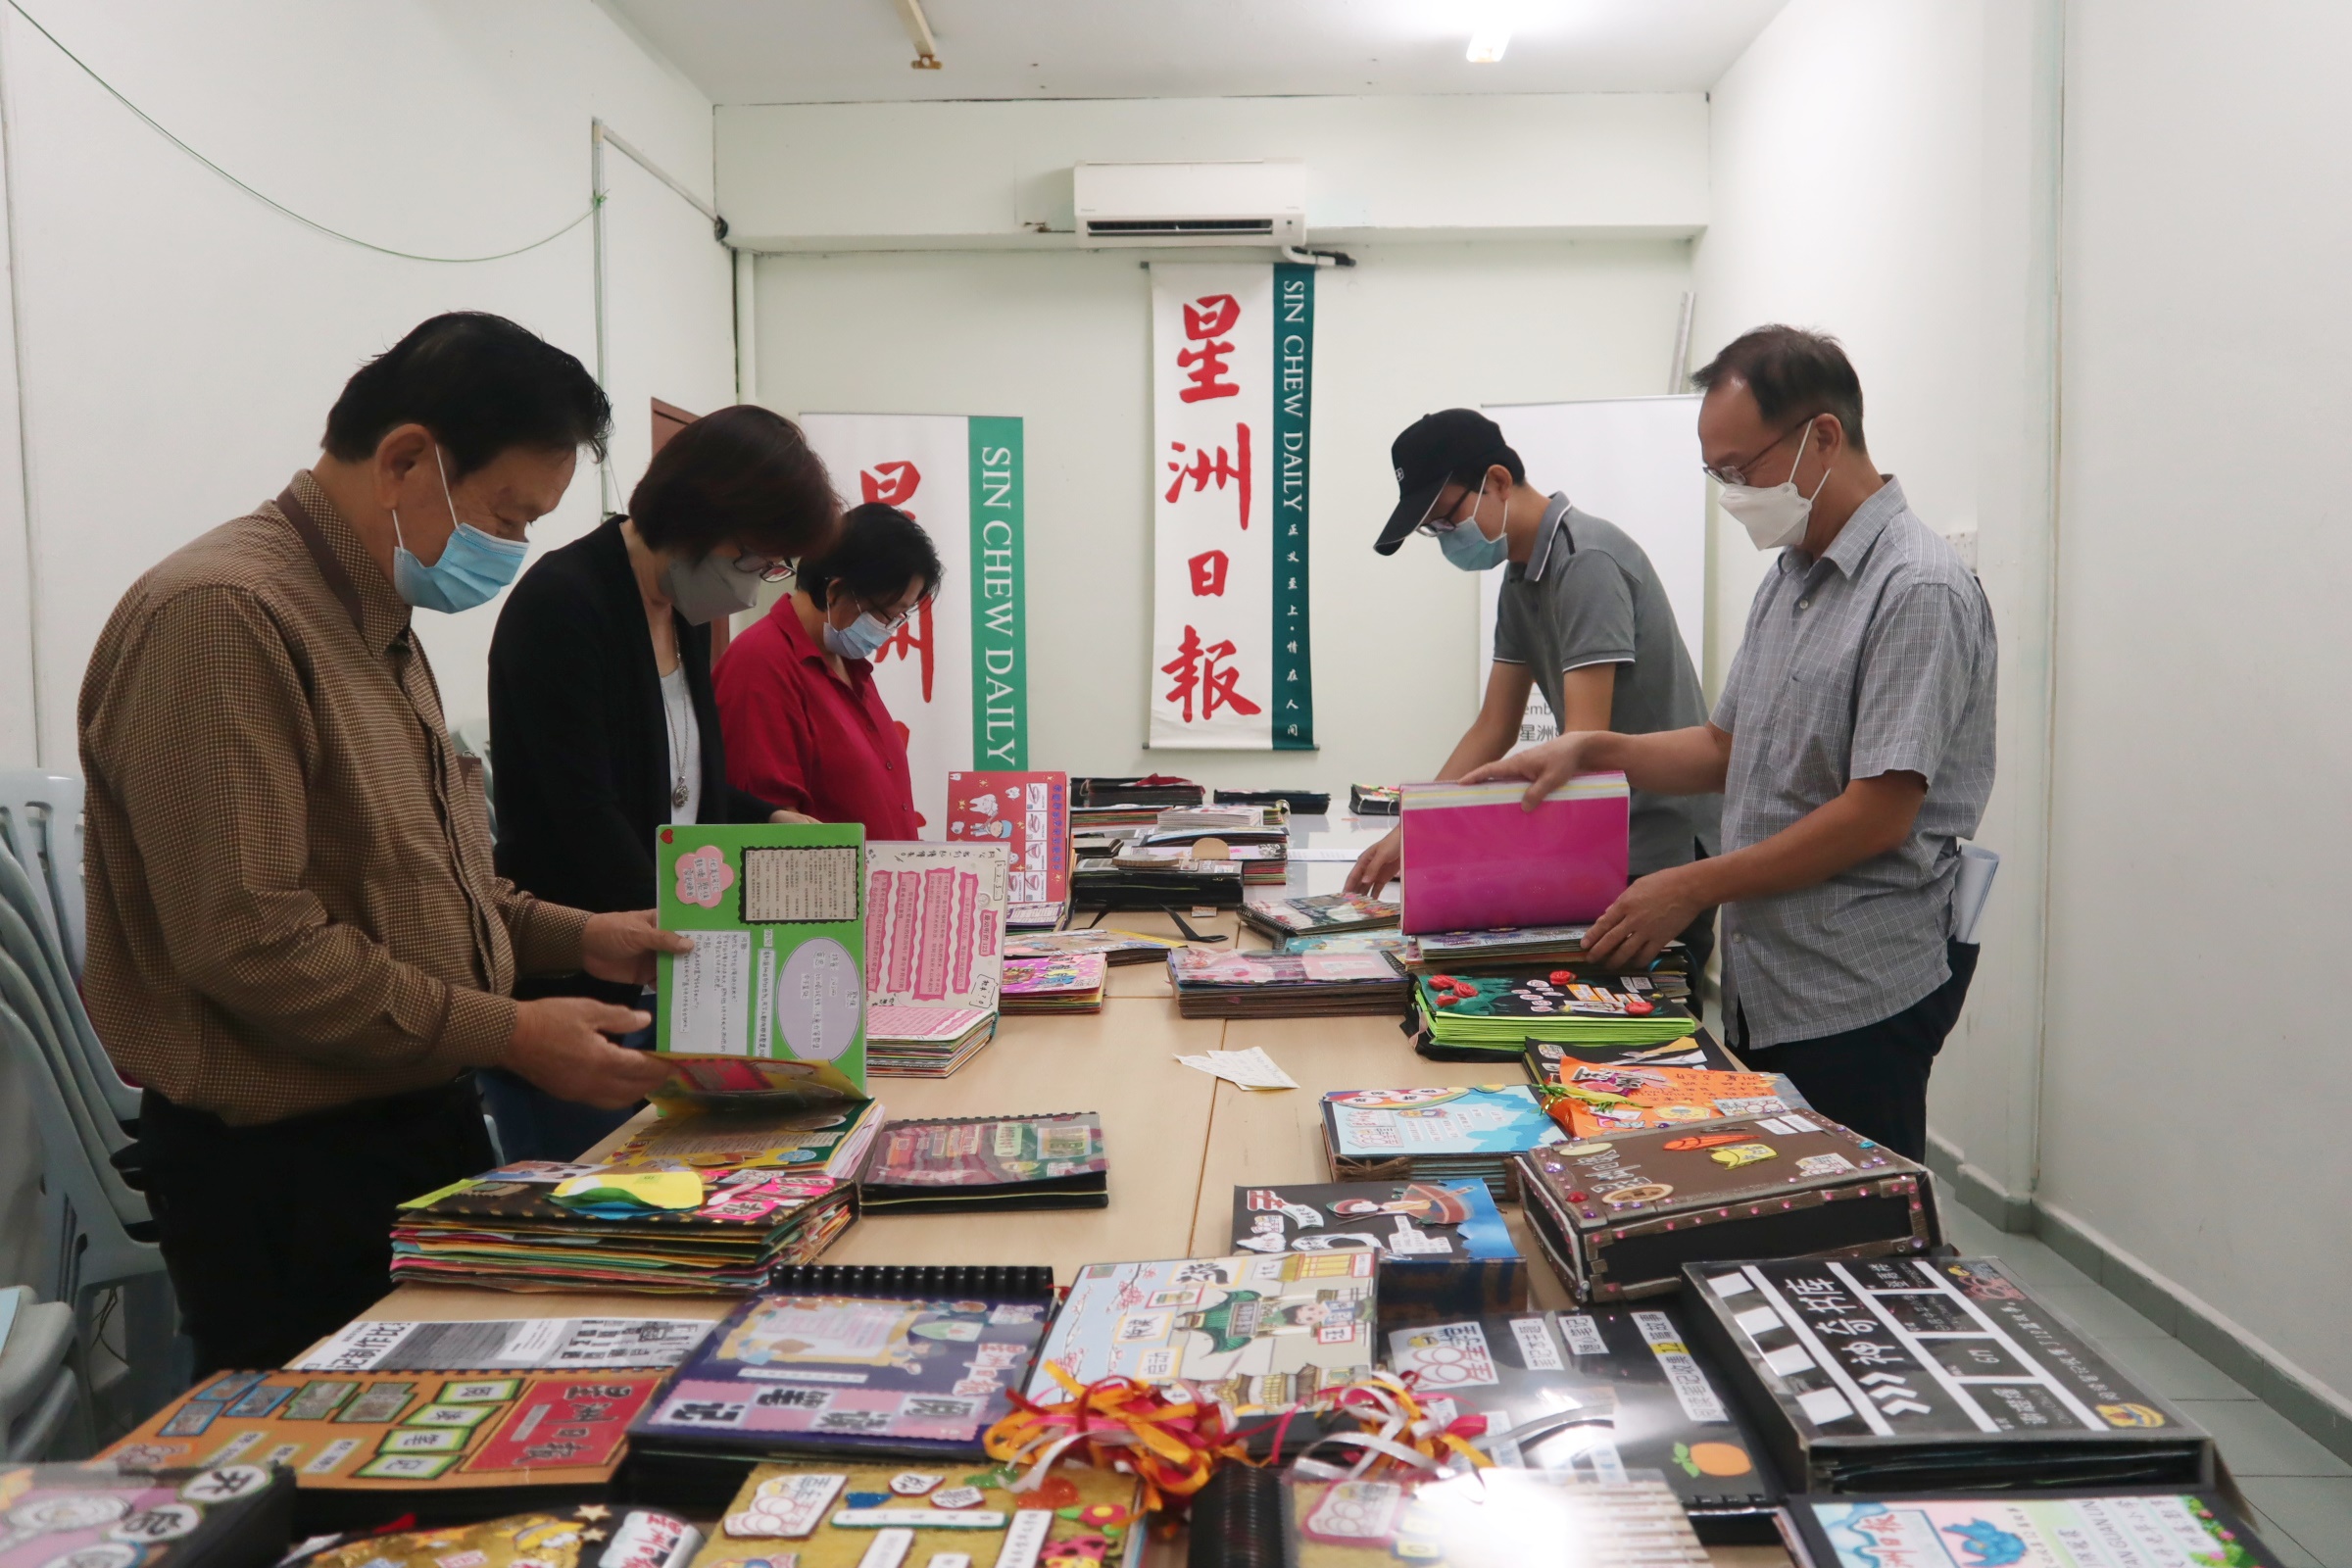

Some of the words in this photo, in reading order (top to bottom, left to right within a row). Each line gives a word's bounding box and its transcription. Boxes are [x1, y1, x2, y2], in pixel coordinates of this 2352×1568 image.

[1284, 280, 1304, 323] SIN
[1283, 335, 1303, 417] CHEW
[982, 448, 1011, 509] SIN
[1283, 432, 1302, 512] DAILY
[983, 520, 1013, 636] CHEW
[985, 649, 1015, 765] DAILY
[1520, 724, 1559, 741] 星洲
[1784, 1277, 1906, 1366] 神奇书库
